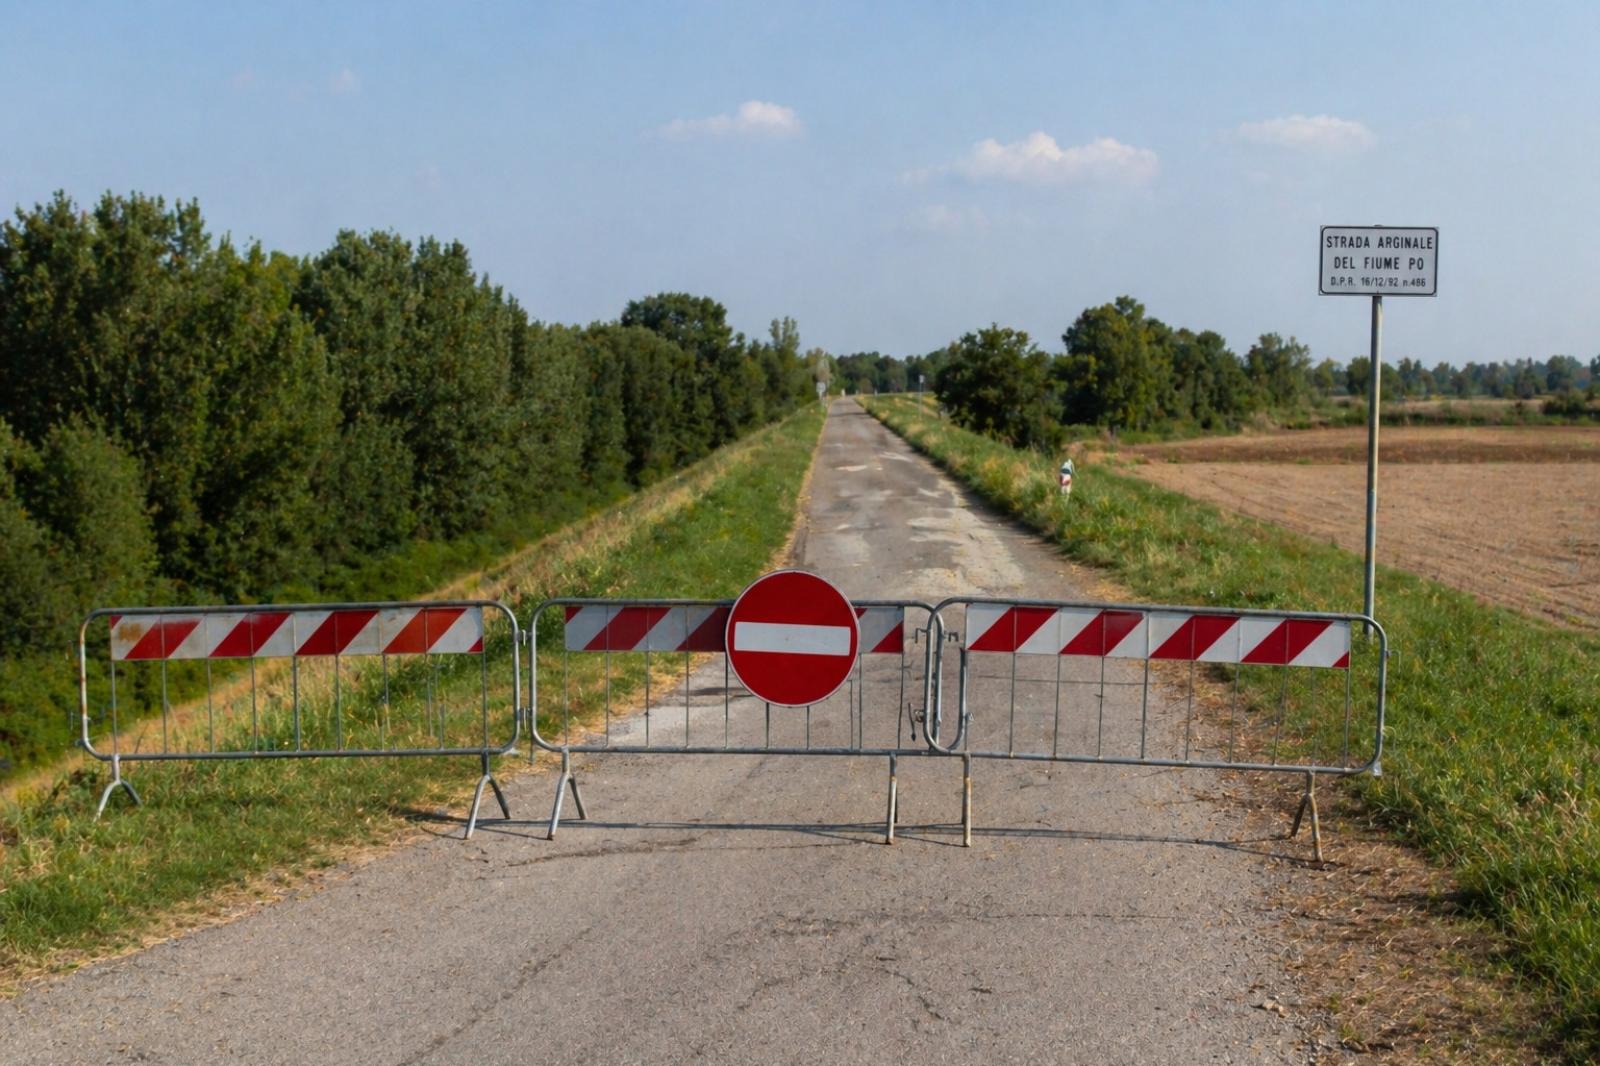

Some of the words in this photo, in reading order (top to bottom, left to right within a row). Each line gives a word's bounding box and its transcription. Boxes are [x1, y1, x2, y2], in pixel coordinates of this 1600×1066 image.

[1326, 236, 1370, 249] STRADA
[1377, 236, 1433, 249] ARGINALE
[1333, 256, 1356, 270] DEL
[1364, 257, 1400, 270] FIUME
[1408, 257, 1425, 270] PO
[1330, 276, 1356, 287] D.P.R.
[1361, 276, 1399, 287] 16/12/92
